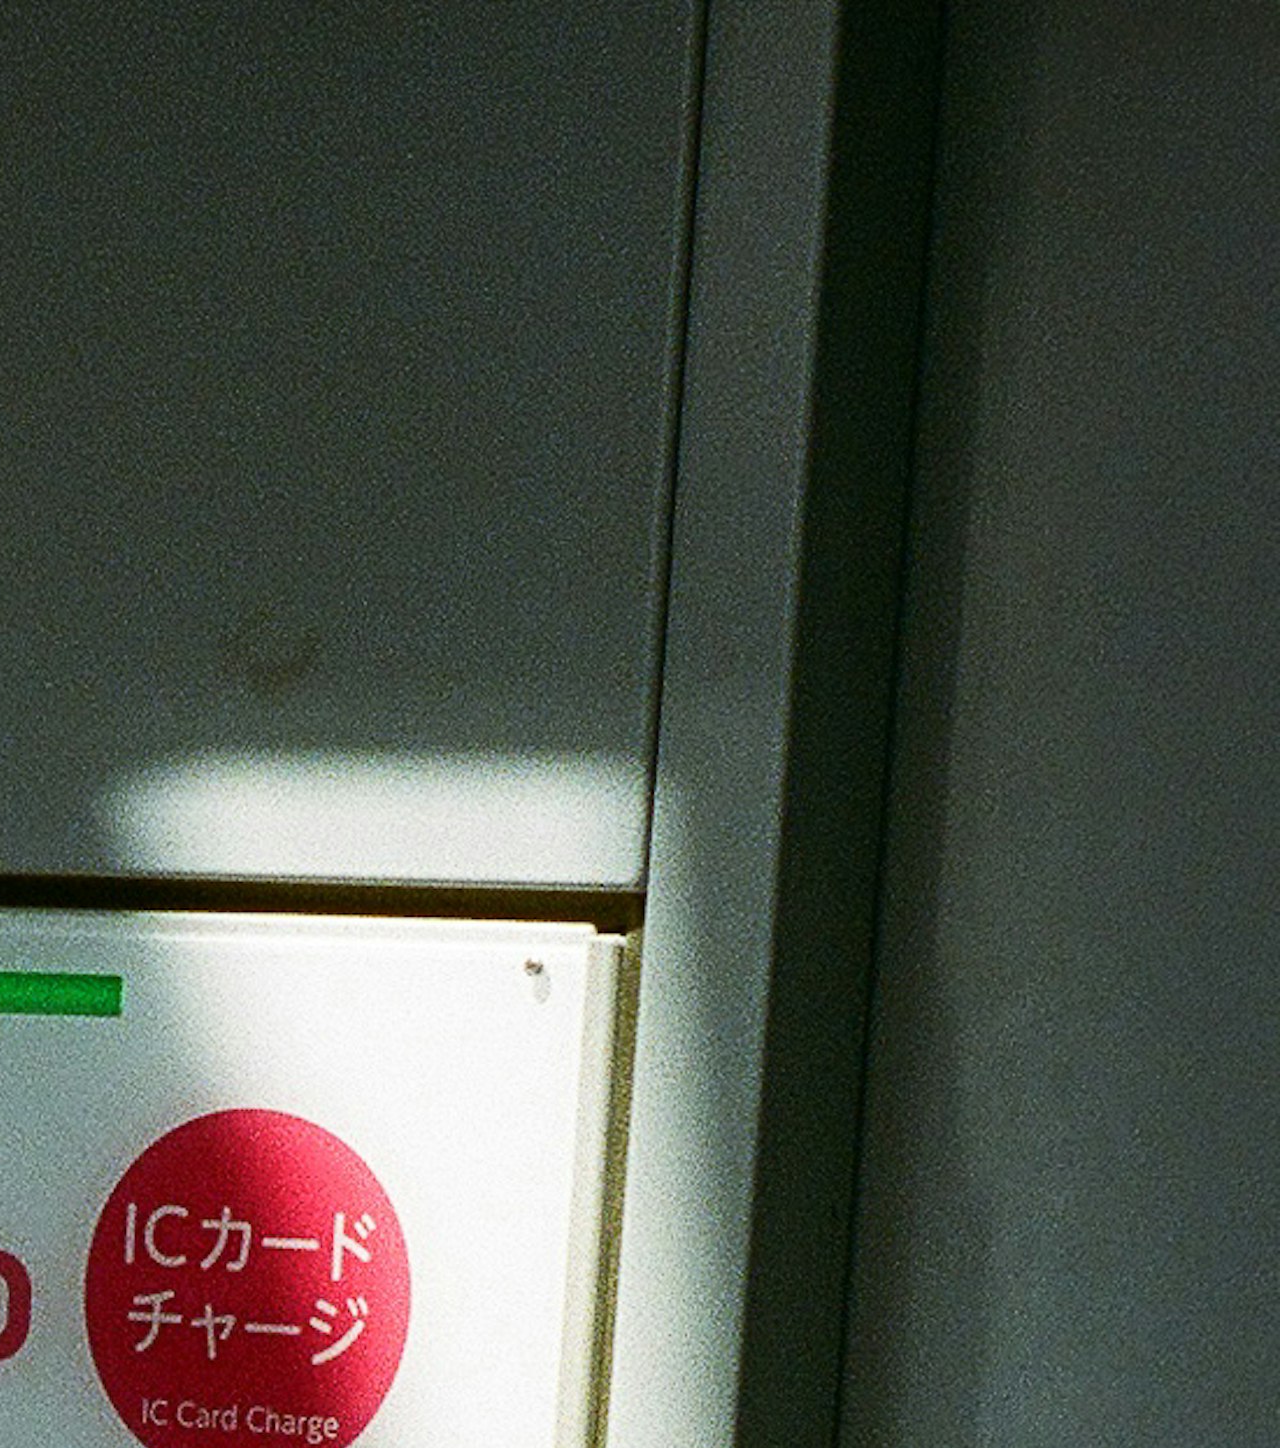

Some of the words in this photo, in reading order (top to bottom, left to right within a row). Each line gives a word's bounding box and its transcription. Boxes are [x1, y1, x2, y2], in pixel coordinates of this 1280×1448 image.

[123, 1201, 377, 1282] ICカード
[126, 1289, 369, 1366] チャージ
[140, 1396, 171, 1428] IC
[176, 1399, 241, 1436] Card
[247, 1404, 340, 1445] Charge
